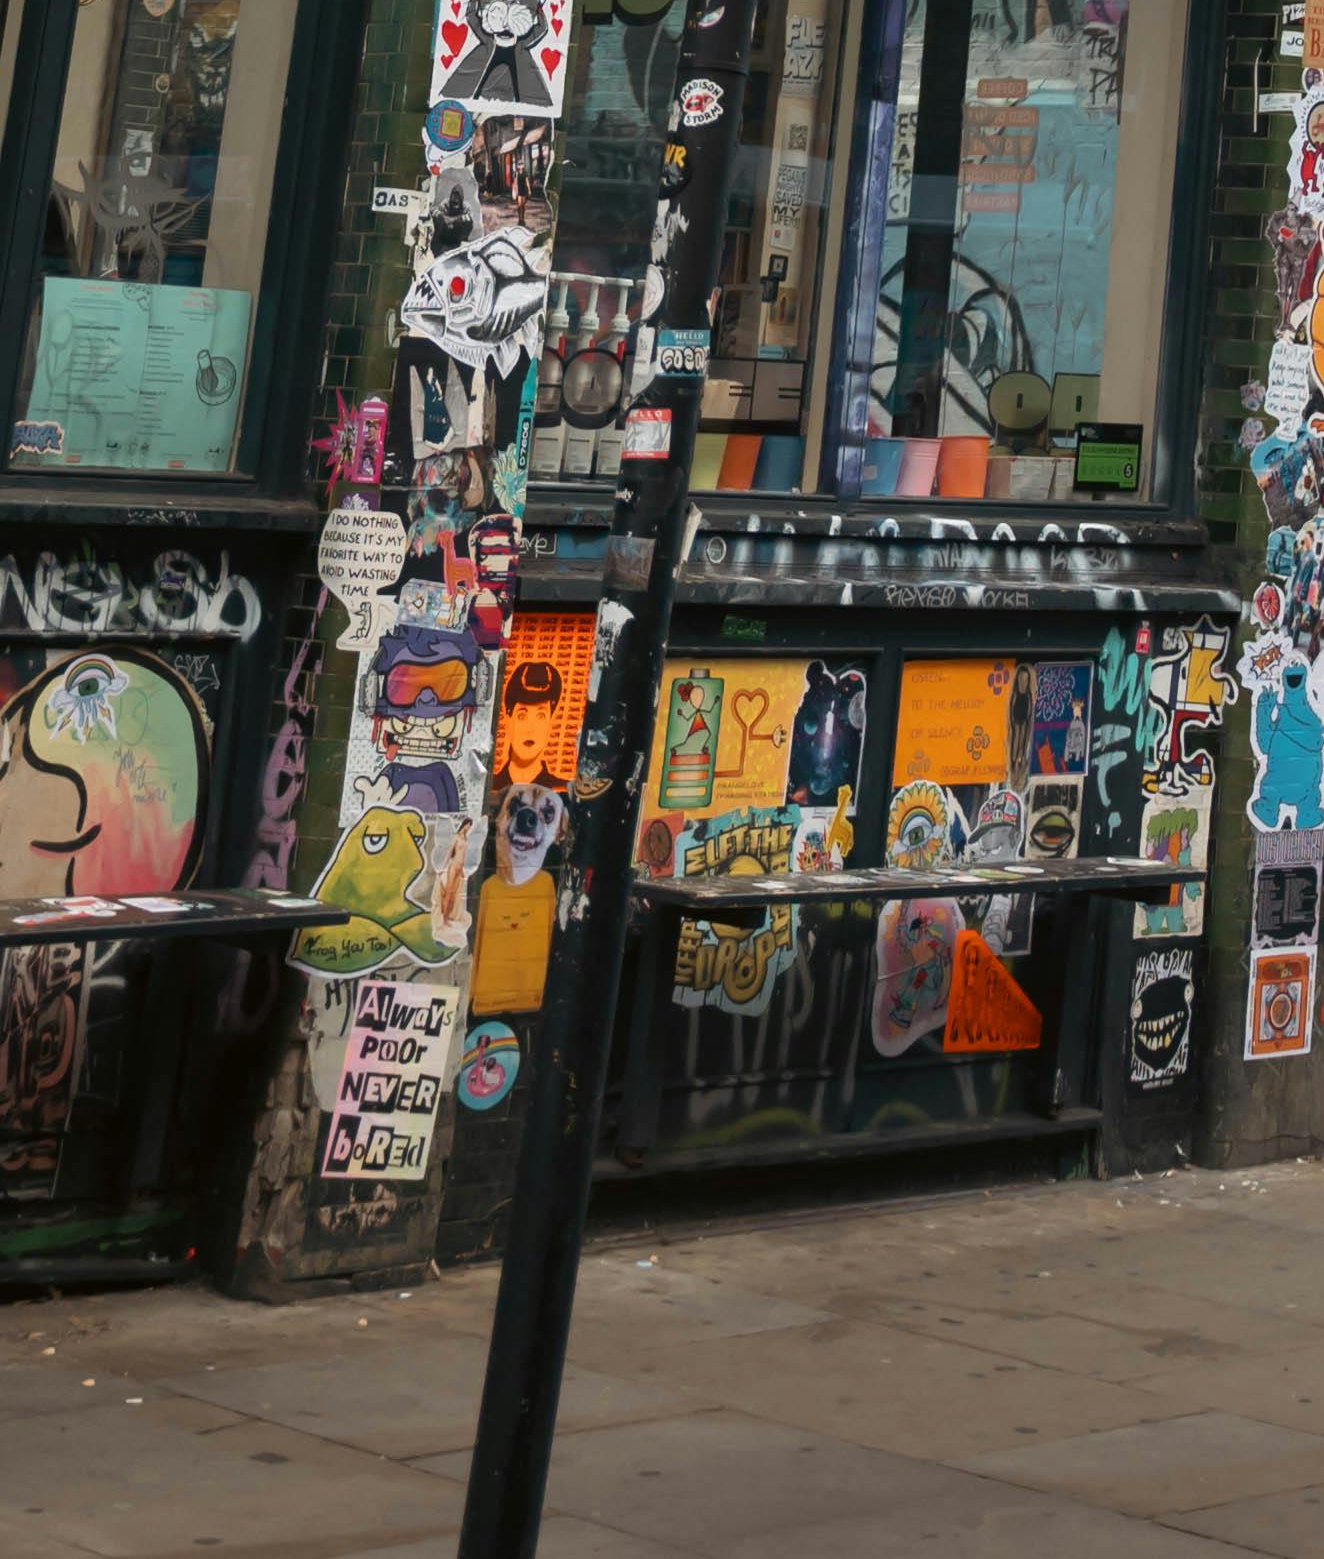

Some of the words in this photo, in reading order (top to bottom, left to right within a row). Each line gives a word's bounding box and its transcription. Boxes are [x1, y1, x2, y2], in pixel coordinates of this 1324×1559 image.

[682, 81, 721, 99] MADISON
[685, 104, 721, 124] STORM
[336, 515, 350, 525] DO
[352, 515, 399, 529] NOTHING
[323, 531, 361, 544] BECAUSE
[363, 533, 384, 545] IT'S
[385, 535, 404, 547] MY
[363, 552, 388, 564] WAY
[390, 552, 403, 564] TO
[348, 568, 397, 581] WASTING
[341, 584, 369, 597] TIME
[340, 1071, 439, 1113] NEVER
